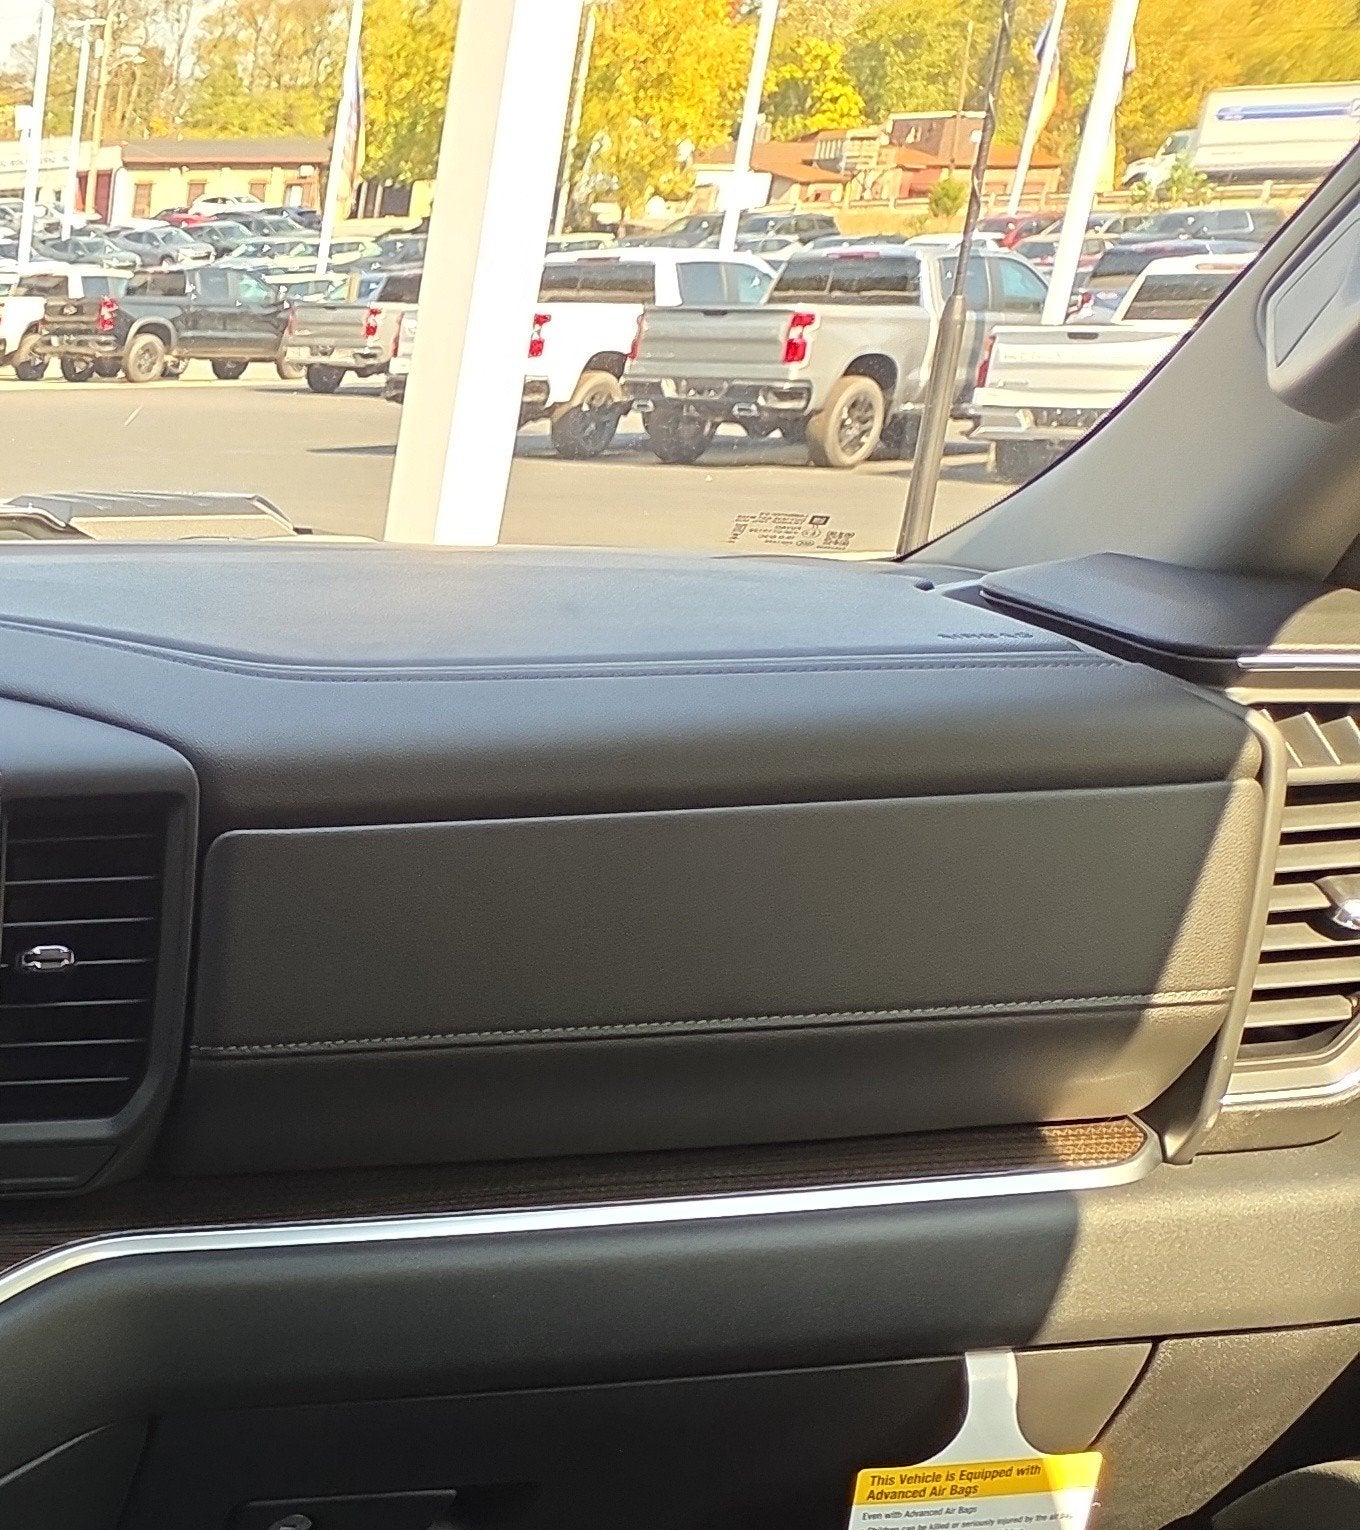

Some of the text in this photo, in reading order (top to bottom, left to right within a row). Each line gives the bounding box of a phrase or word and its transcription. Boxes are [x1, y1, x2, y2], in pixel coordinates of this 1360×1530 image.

[869, 1464, 1041, 1487] This Vehicle is Equipped with
[867, 1483, 979, 1500] Advanced Air Bags
[904, 1508, 943, 1518] Advanced
[945, 1507, 955, 1515] Air
[958, 1506, 977, 1514] Bags
